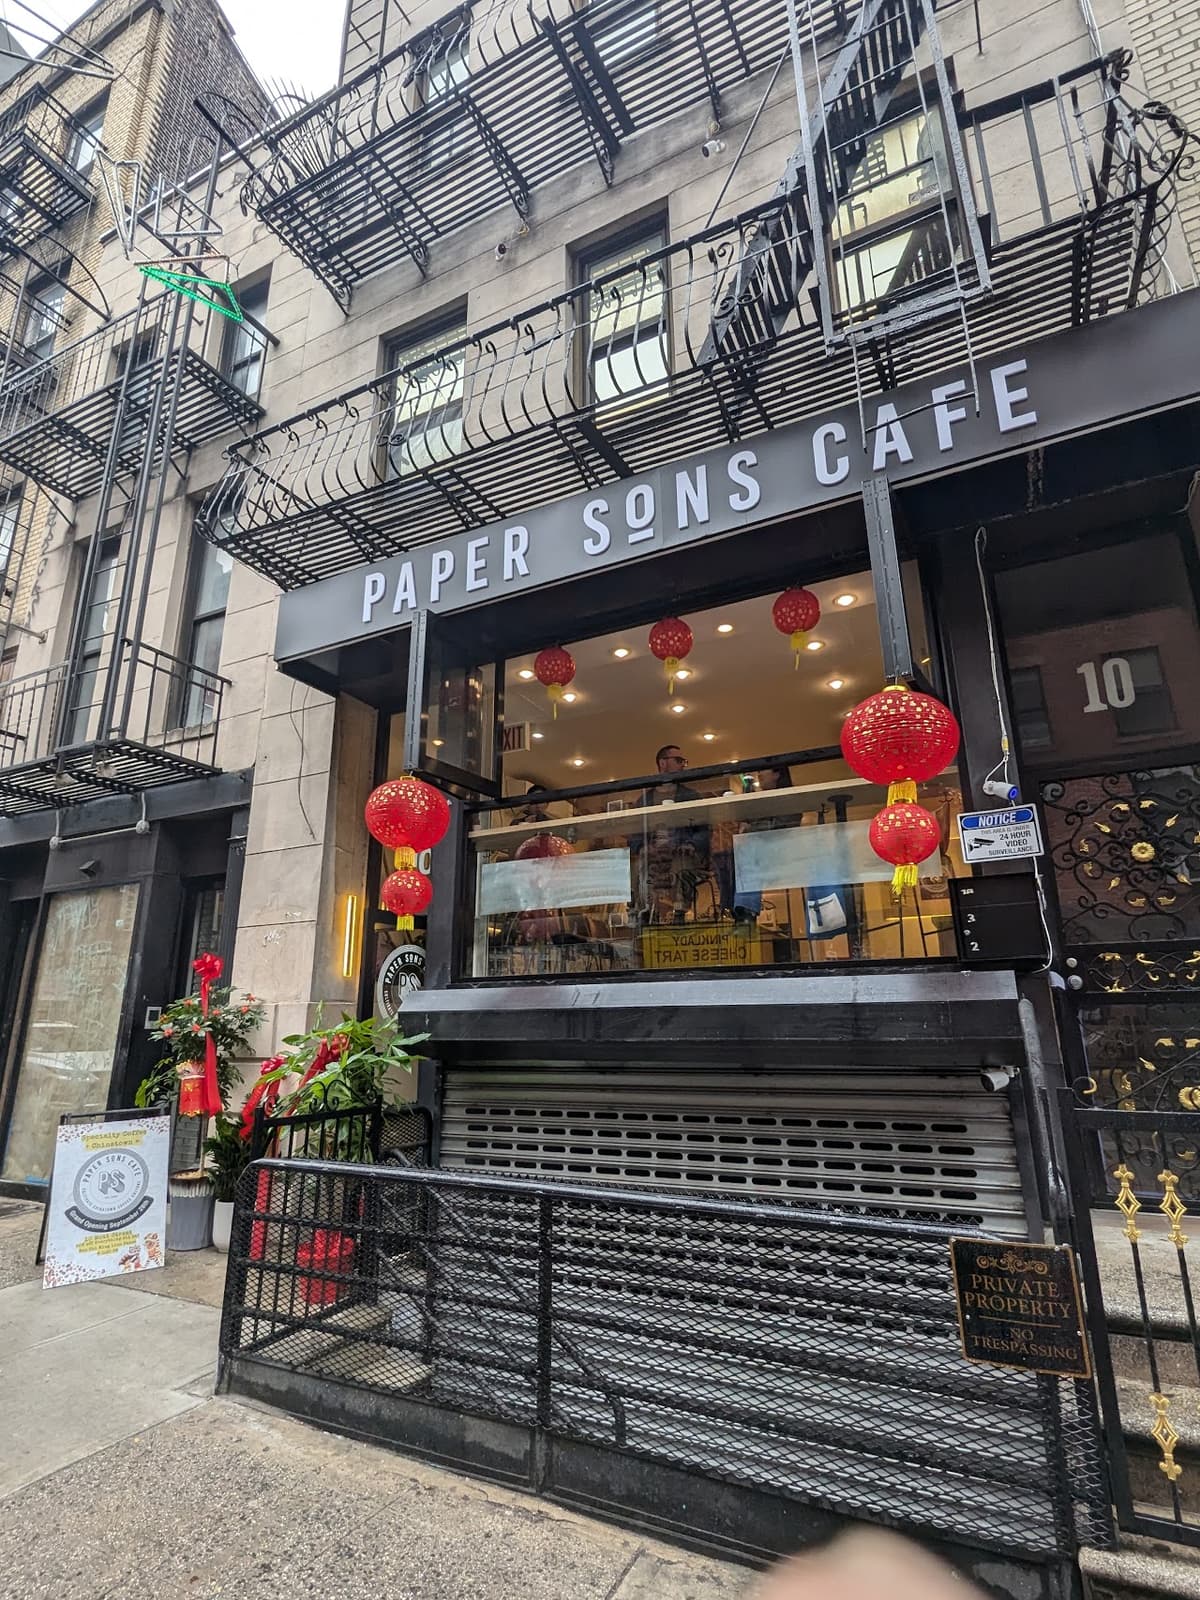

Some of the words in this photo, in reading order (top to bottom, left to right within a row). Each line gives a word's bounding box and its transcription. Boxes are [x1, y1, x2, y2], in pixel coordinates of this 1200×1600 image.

[362, 525, 530, 623] PAPER
[583, 450, 761, 556] SONS
[812, 358, 1038, 486] CAFE
[1077, 657, 1136, 713] 10
[503, 726, 523, 752] XIT
[978, 812, 1017, 828] NOTICE
[1000, 833, 1009, 841] 24
[1010, 830, 1031, 839] HOUR
[1005, 838, 1027, 846] VIDEO
[989, 846, 1033, 856] SURVEILLANCE
[967, 913, 976, 923] 3
[969, 941, 980, 951] 2
[384, 957, 404, 985] PAPER
[404, 953, 423, 966] SONS
[82, 1161, 102, 1184] PAPER
[106, 1155, 126, 1163] SONS
[127, 1160, 142, 1178] CAFE
[70, 1209, 85, 1226] Grand
[84, 1221, 108, 1231] Opening
[109, 1211, 139, 1230] September
[971, 1274, 1060, 1298] PRIVATE
[964, 1291, 1072, 1319] PROPERTY
[1009, 1327, 1034, 1341] NO
[971, 1335, 1079, 1360] TRESPASSING
